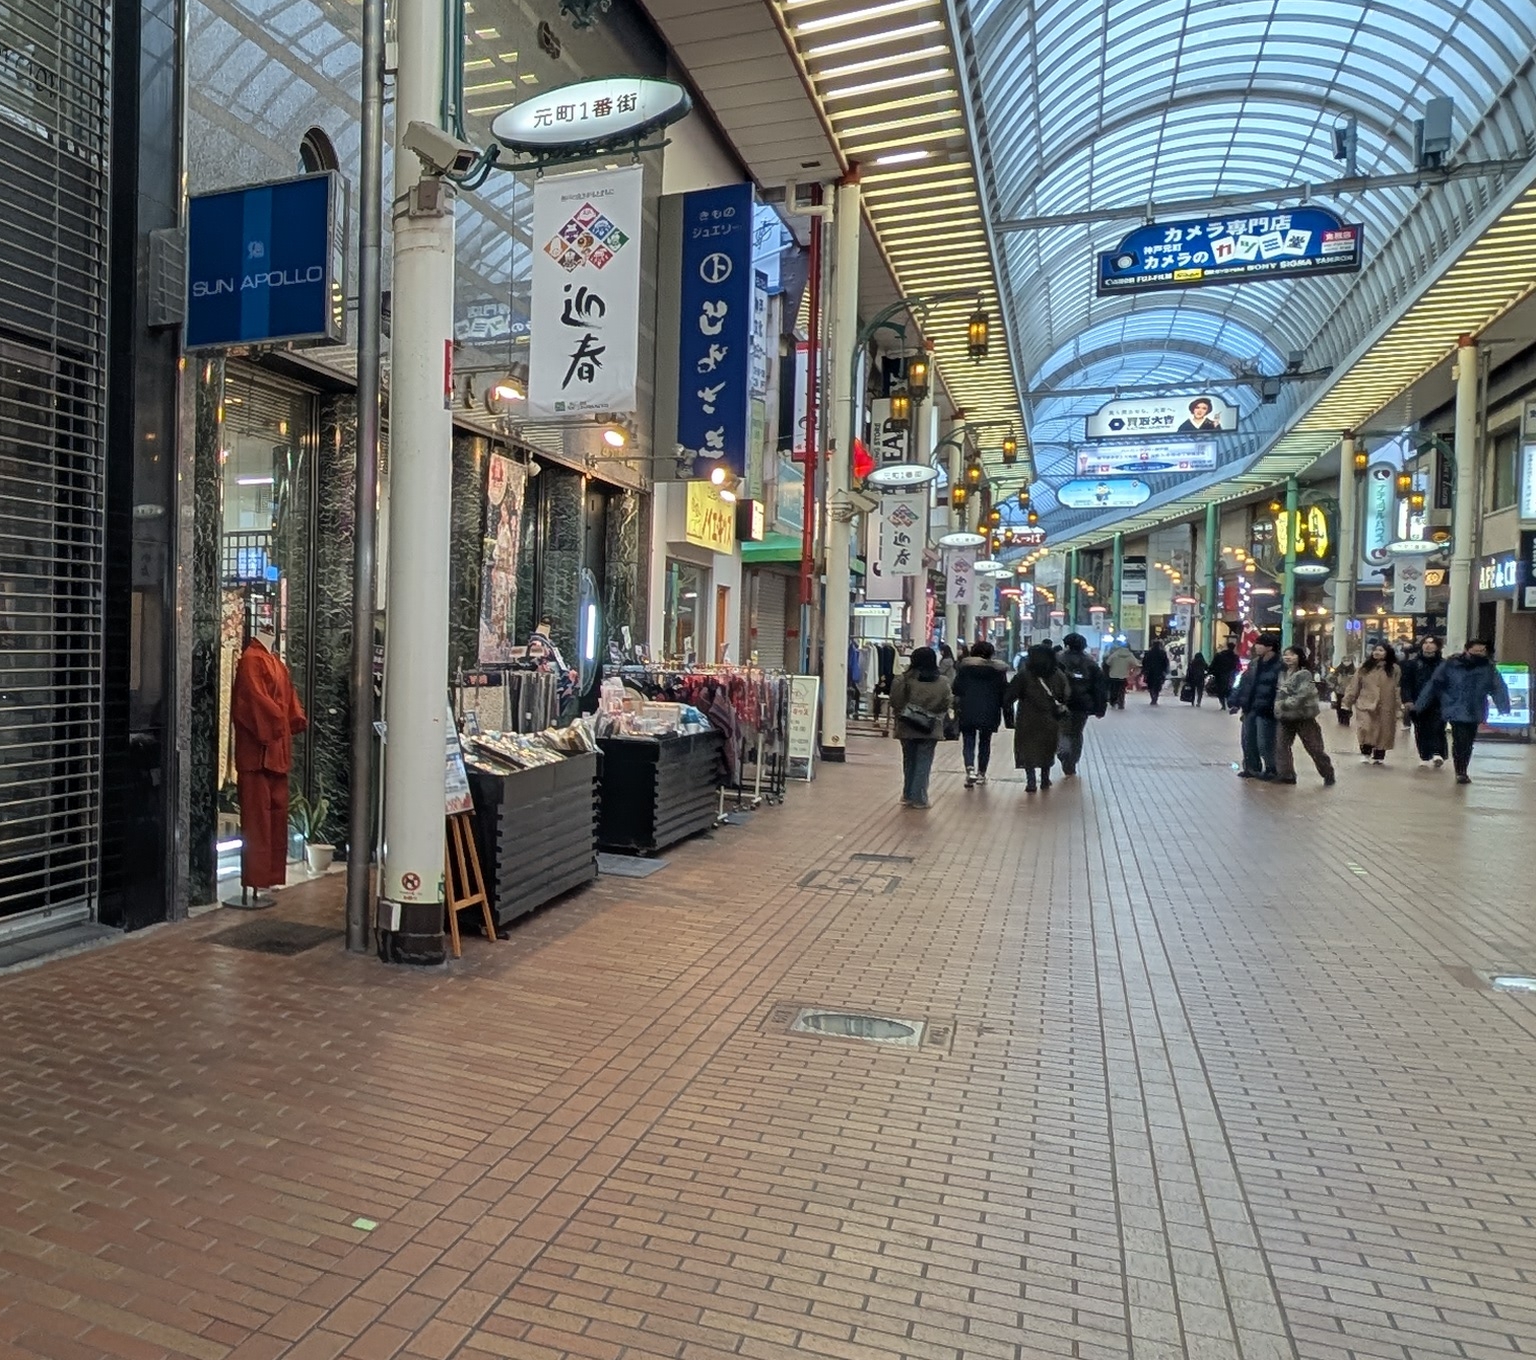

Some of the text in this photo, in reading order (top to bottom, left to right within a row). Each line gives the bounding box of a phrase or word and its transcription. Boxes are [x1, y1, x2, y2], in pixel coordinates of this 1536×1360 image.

[533, 92, 638, 129] 元町1番街
[698, 206, 736, 222] きもの
[1164, 214, 1293, 244] カメラ専門店
[692, 224, 742, 239] ジュエリー
[1247, 262, 1277, 271] SONY
[1279, 258, 1313, 269] SIGMA
[192, 265, 323, 297] SUN APOLLO
[560, 283, 607, 390] 迎春
